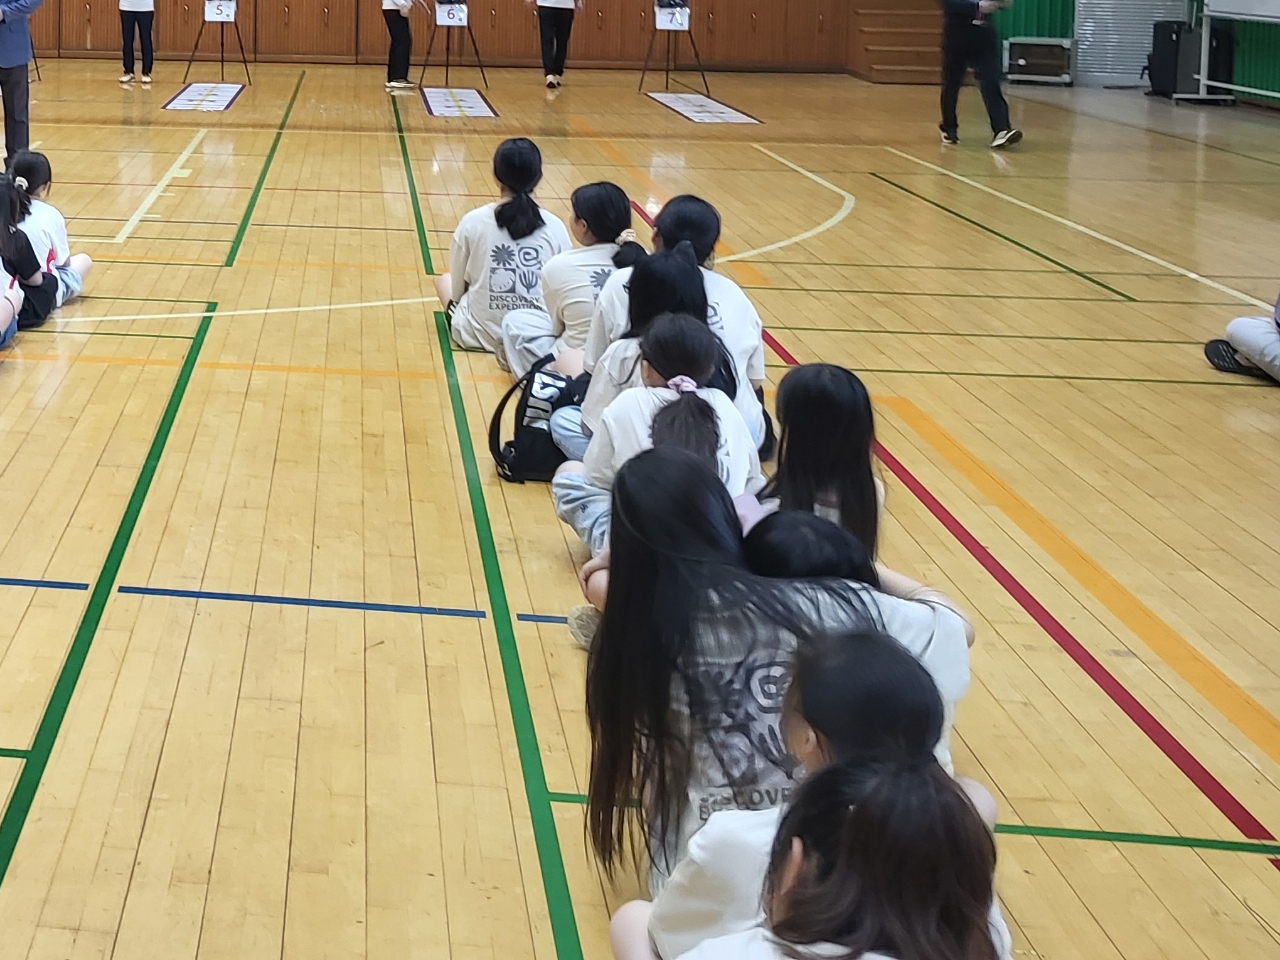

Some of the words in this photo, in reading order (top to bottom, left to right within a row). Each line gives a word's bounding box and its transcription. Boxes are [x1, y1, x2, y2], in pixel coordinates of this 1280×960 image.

[215, 4, 224, 16] 5
[447, 8, 456, 20] 6
[667, 12, 677, 24] 7
[489, 294, 541, 304] DISCOVERY
